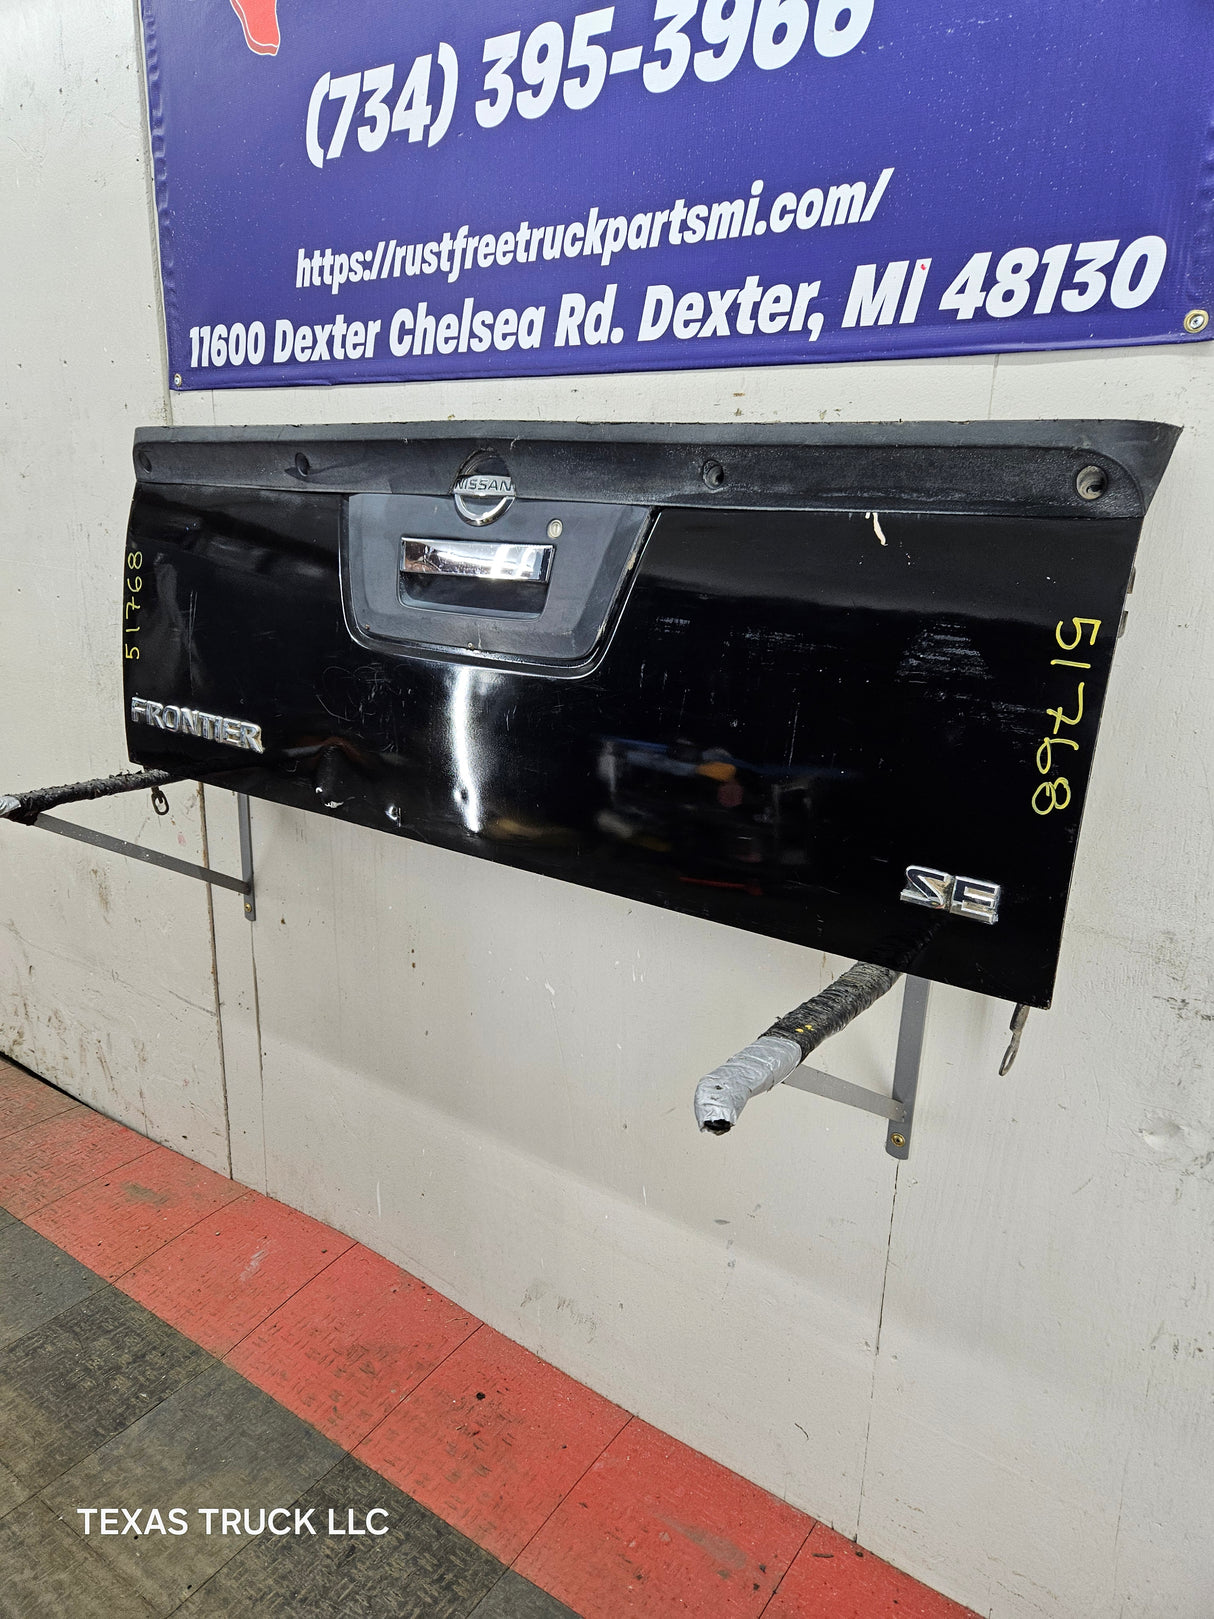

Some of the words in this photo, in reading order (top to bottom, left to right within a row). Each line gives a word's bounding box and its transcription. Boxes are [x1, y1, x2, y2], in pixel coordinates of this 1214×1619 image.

[306, 41, 459, 168] (734)
[296, 167, 895, 294] https://rustfreetruckpartsmi.com/
[189, 320, 265, 367] 11600
[273, 314, 380, 363] Dexter
[389, 297, 546, 356] Chelsea
[554, 283, 625, 347] Rd.
[637, 274, 822, 342] Dexter,
[841, 257, 932, 328] MI
[938, 235, 1167, 320] 48130
[454, 479, 512, 492] NISSAN
[125, 551, 143, 660] 51768
[131, 696, 265, 755] FRONTIER
[1031, 617, 1101, 816] 51768
[900, 864, 1001, 925] SE
